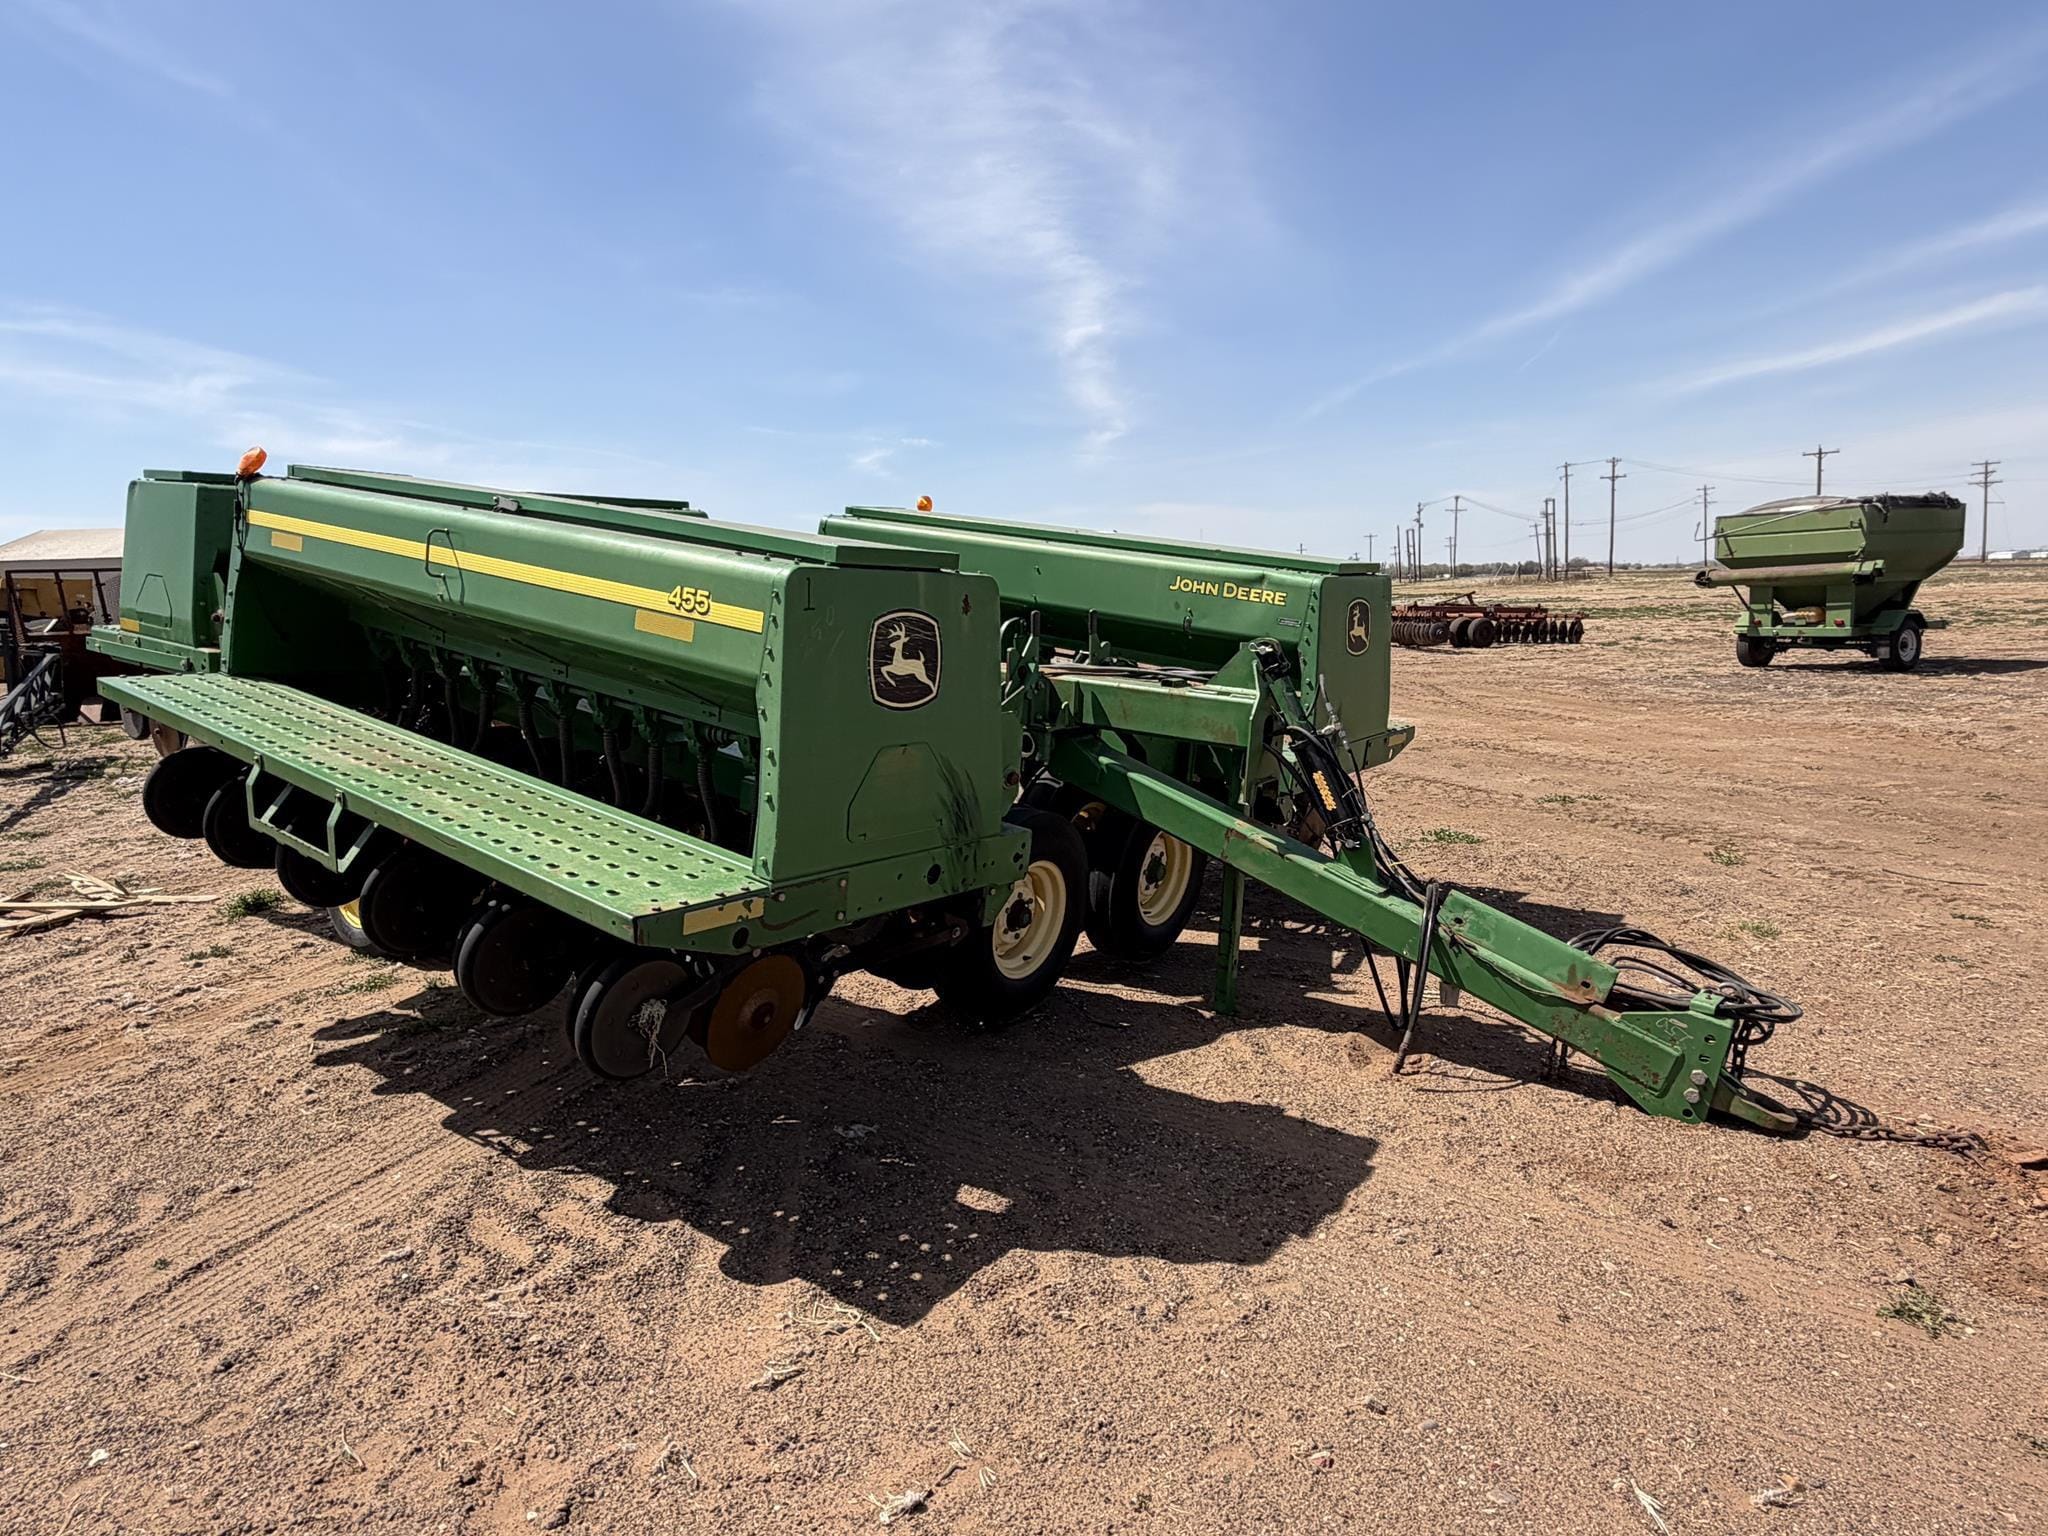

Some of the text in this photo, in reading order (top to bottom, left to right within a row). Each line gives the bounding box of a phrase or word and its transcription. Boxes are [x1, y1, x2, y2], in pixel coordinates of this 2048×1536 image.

[668, 585, 711, 616] 455
[1169, 575, 1287, 606] JOHN DEERE
